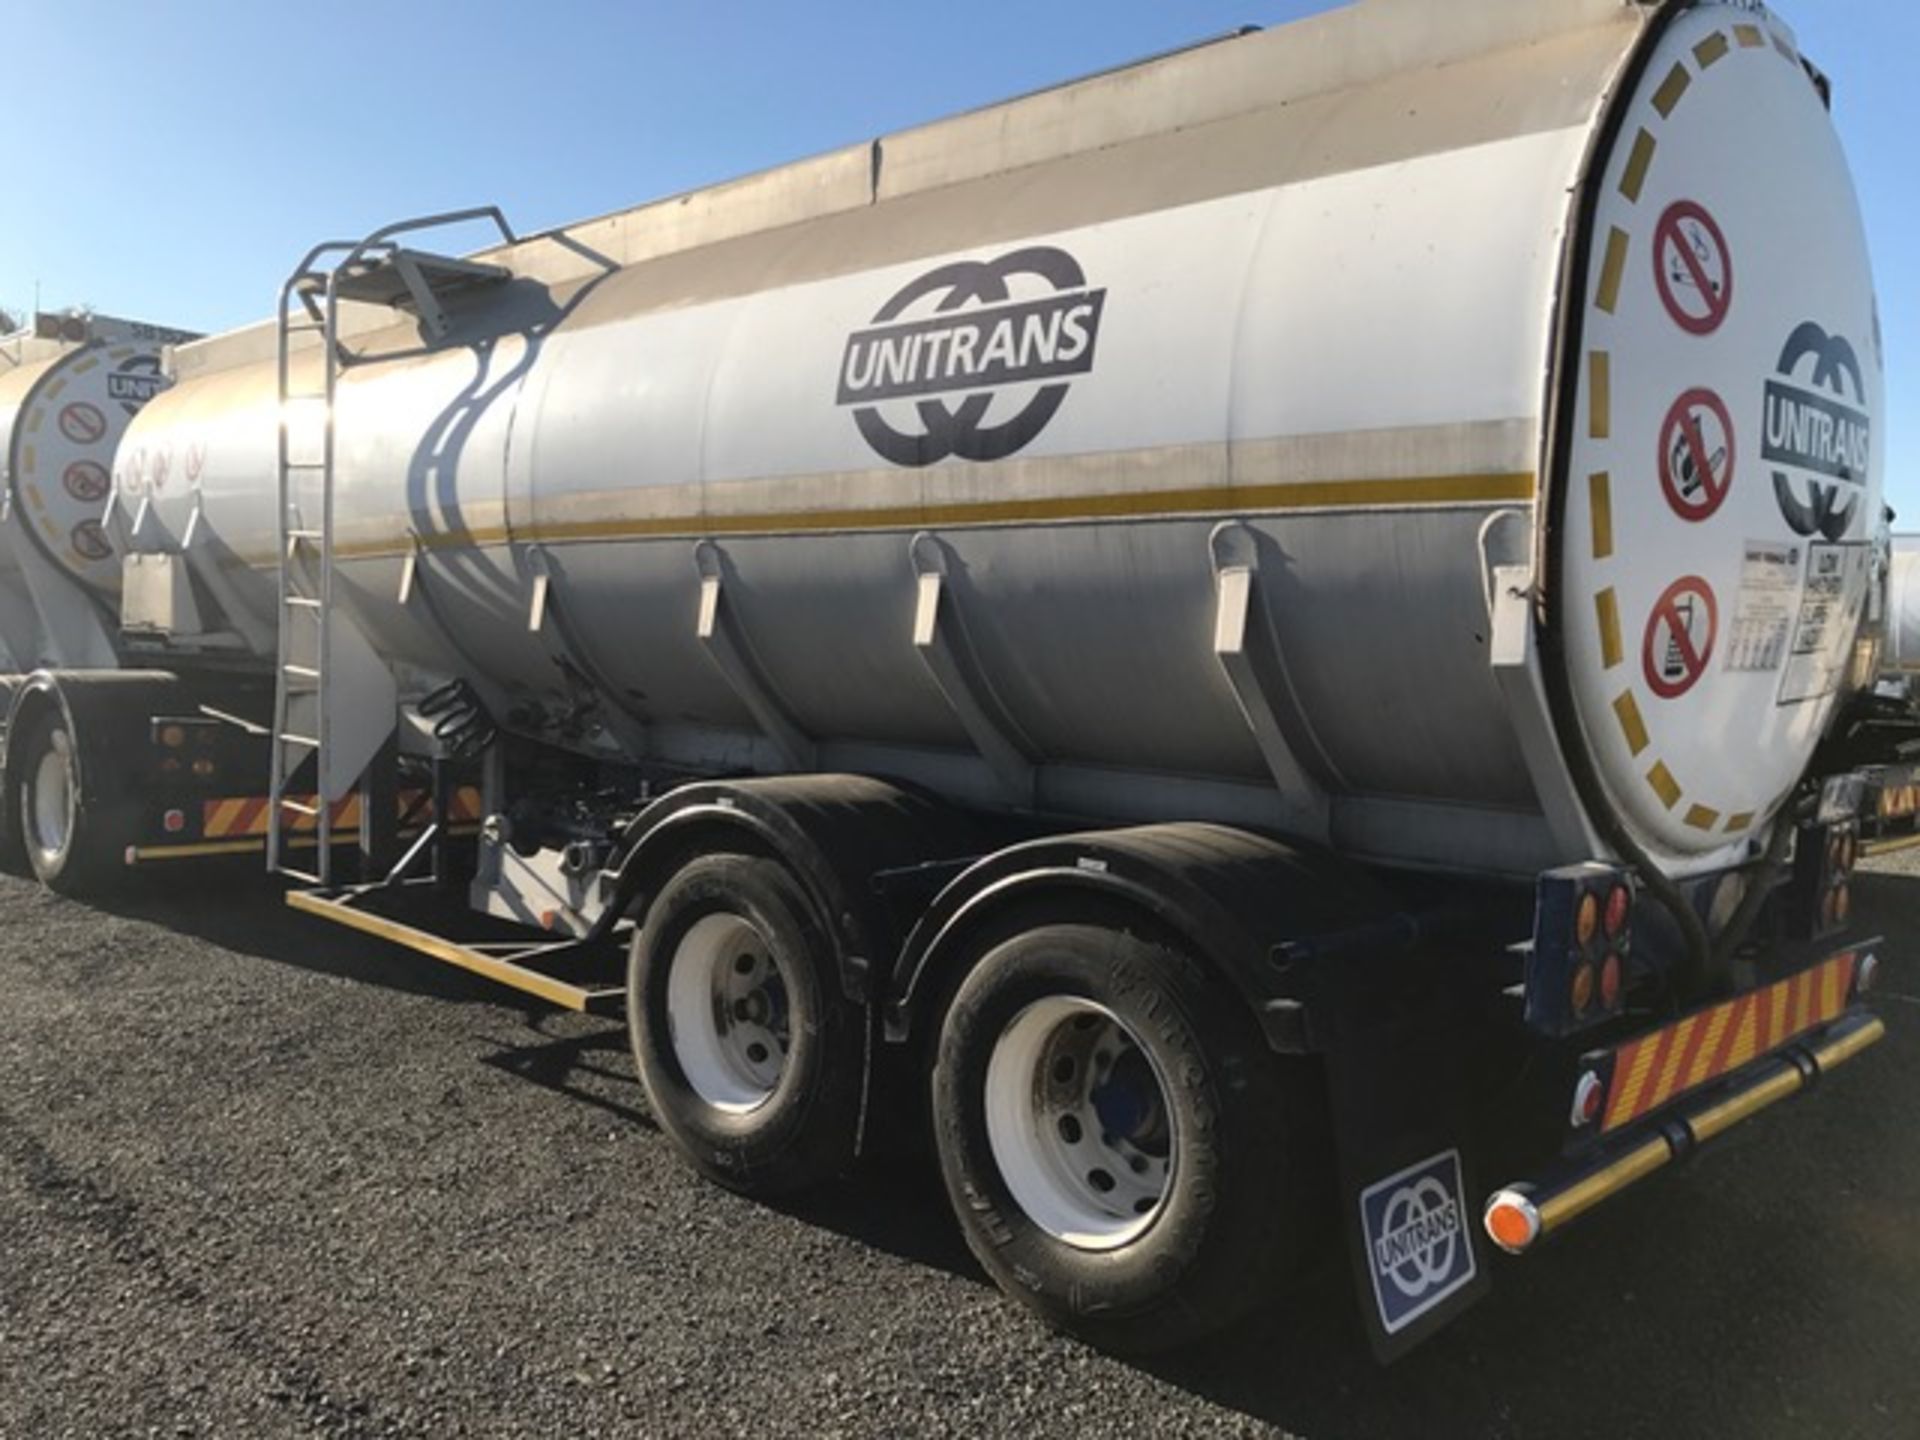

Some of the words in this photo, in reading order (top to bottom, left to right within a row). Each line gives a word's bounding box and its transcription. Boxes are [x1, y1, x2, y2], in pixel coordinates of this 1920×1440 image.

[847, 305, 1093, 391] UNITRANS
[1766, 394, 1868, 471] UNITRANS
[1380, 1202, 1456, 1268] UNITRANS
